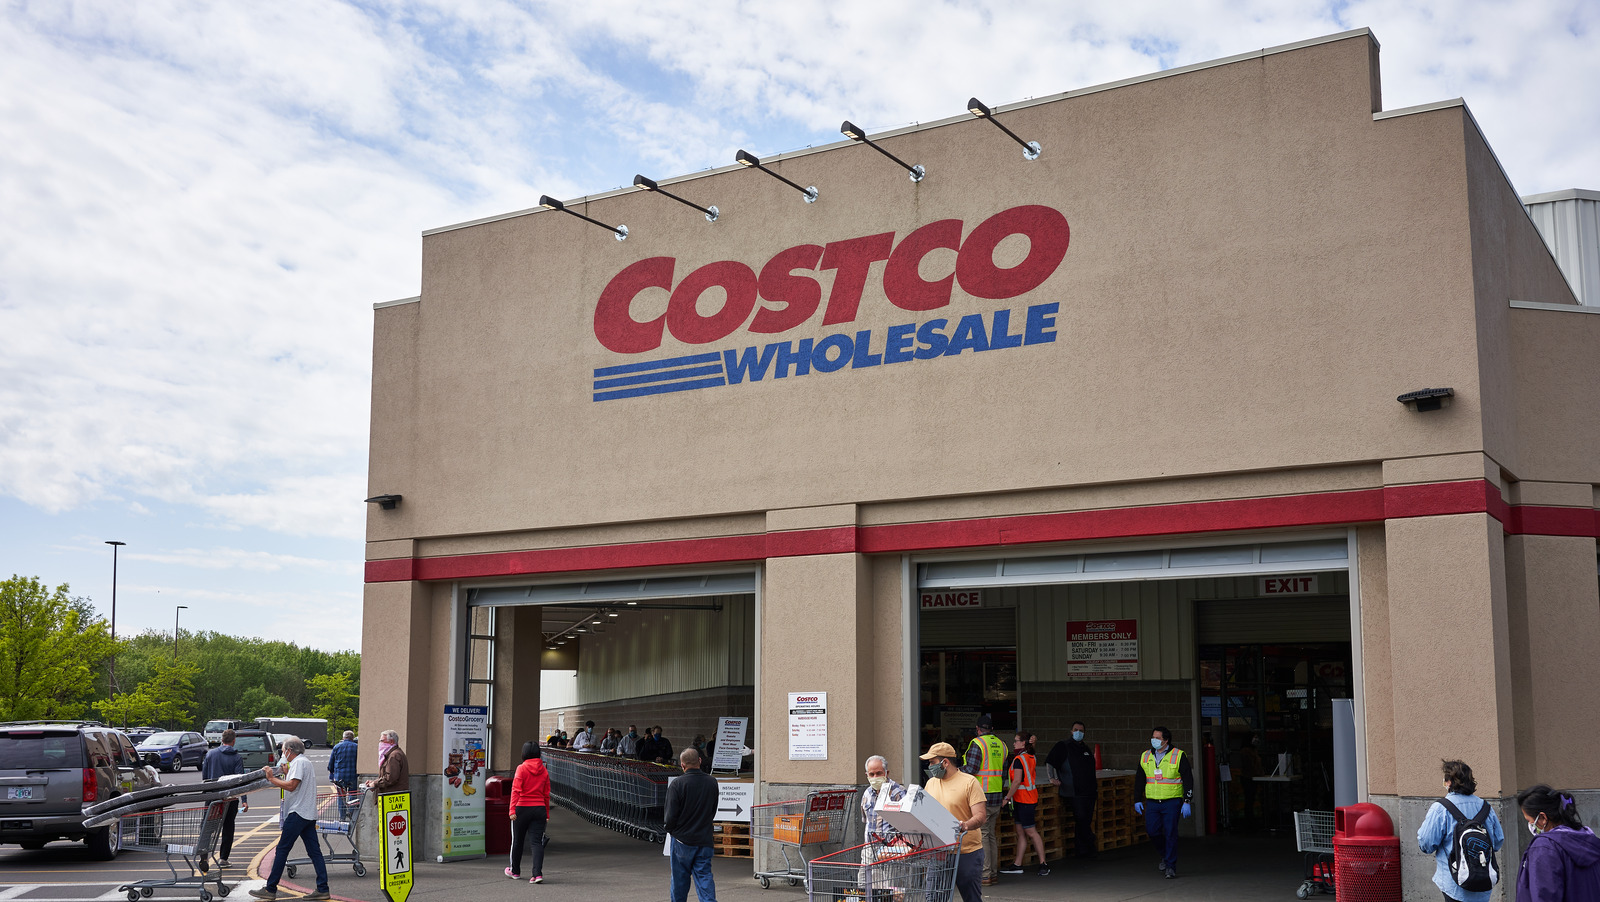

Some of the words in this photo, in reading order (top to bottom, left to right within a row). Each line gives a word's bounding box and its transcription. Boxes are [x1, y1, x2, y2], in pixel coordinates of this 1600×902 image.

[593, 204, 1071, 354] COSTCO
[723, 302, 1060, 386] WHOLESALE
[1265, 577, 1313, 594] EXIT
[922, 592, 980, 608] RANCE
[1071, 633, 1109, 641] MEMBERS
[1111, 632, 1132, 640] ONLY
[448, 715, 484, 724] CostcoGrocery
[390, 822, 406, 830] STOP
